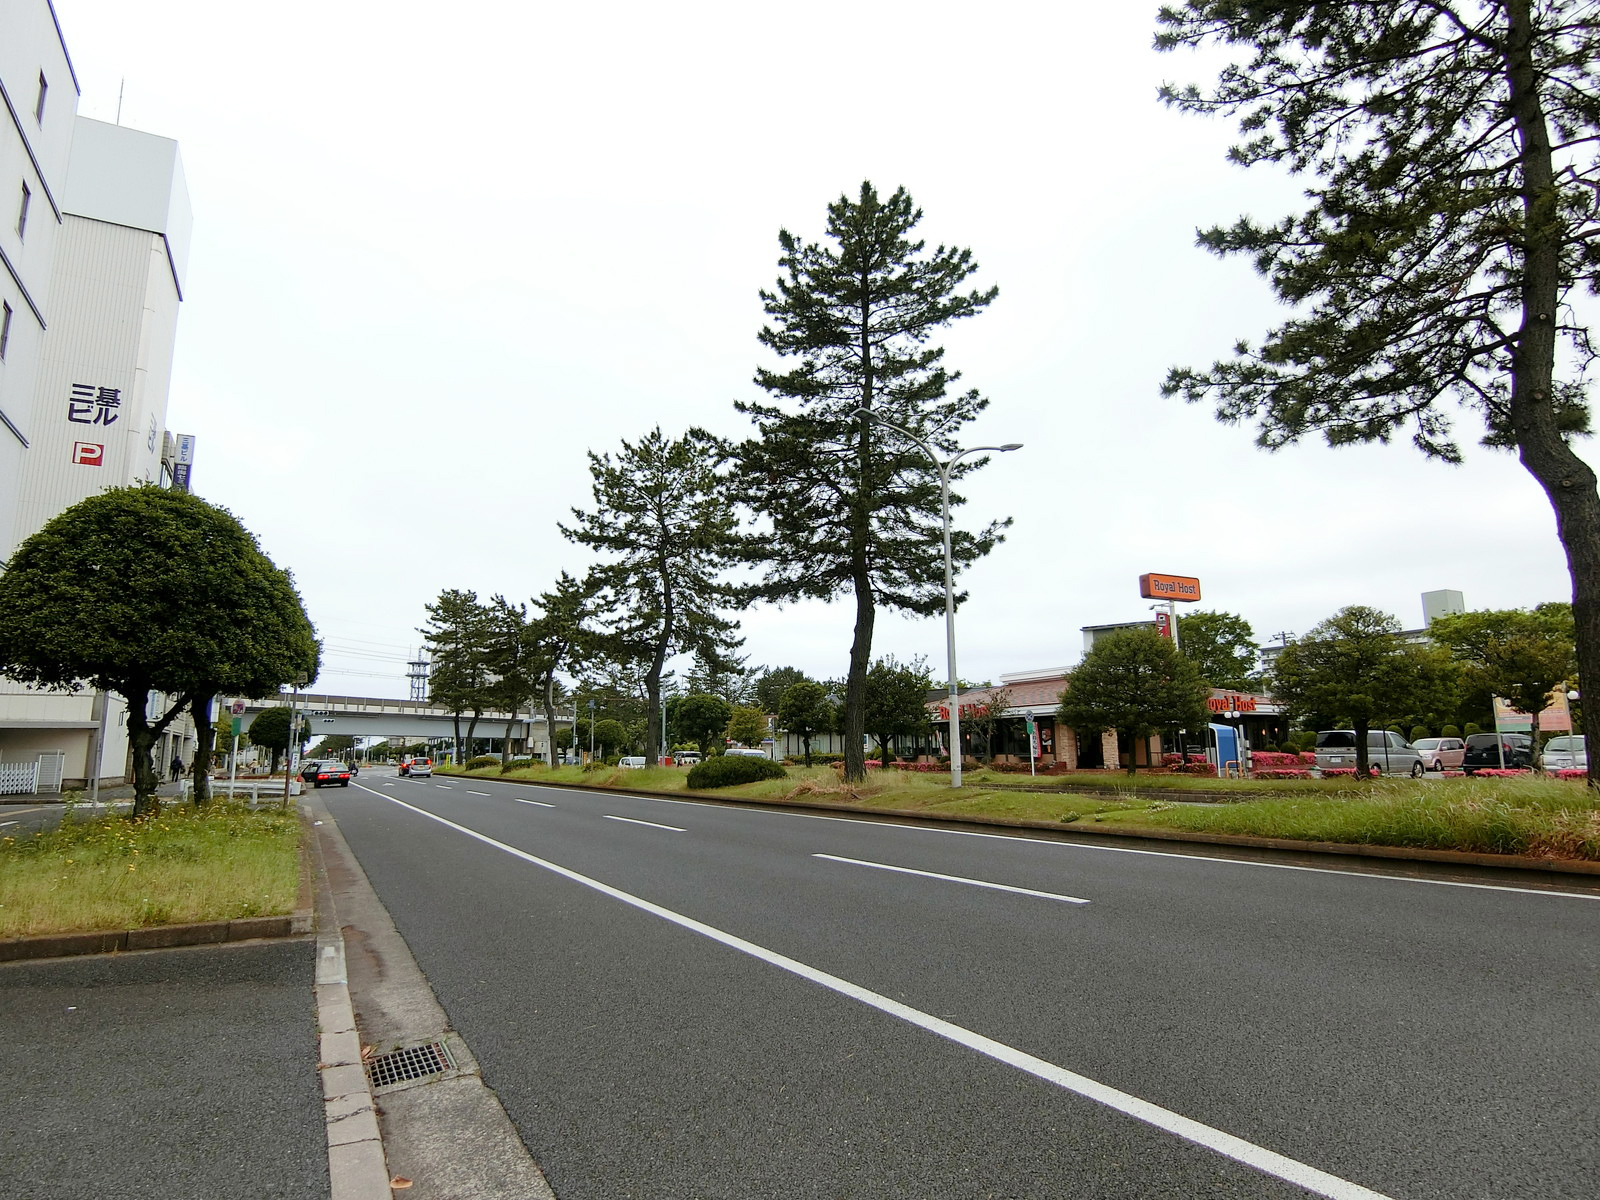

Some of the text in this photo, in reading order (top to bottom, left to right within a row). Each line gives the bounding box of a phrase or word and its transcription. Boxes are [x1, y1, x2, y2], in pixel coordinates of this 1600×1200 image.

[69, 383, 122, 409] 三基
[67, 402, 119, 426] ビル
[74, 442, 102, 464] P
[1152, 579, 1196, 594] Royal Host
[1207, 695, 1256, 713] oyal Host
